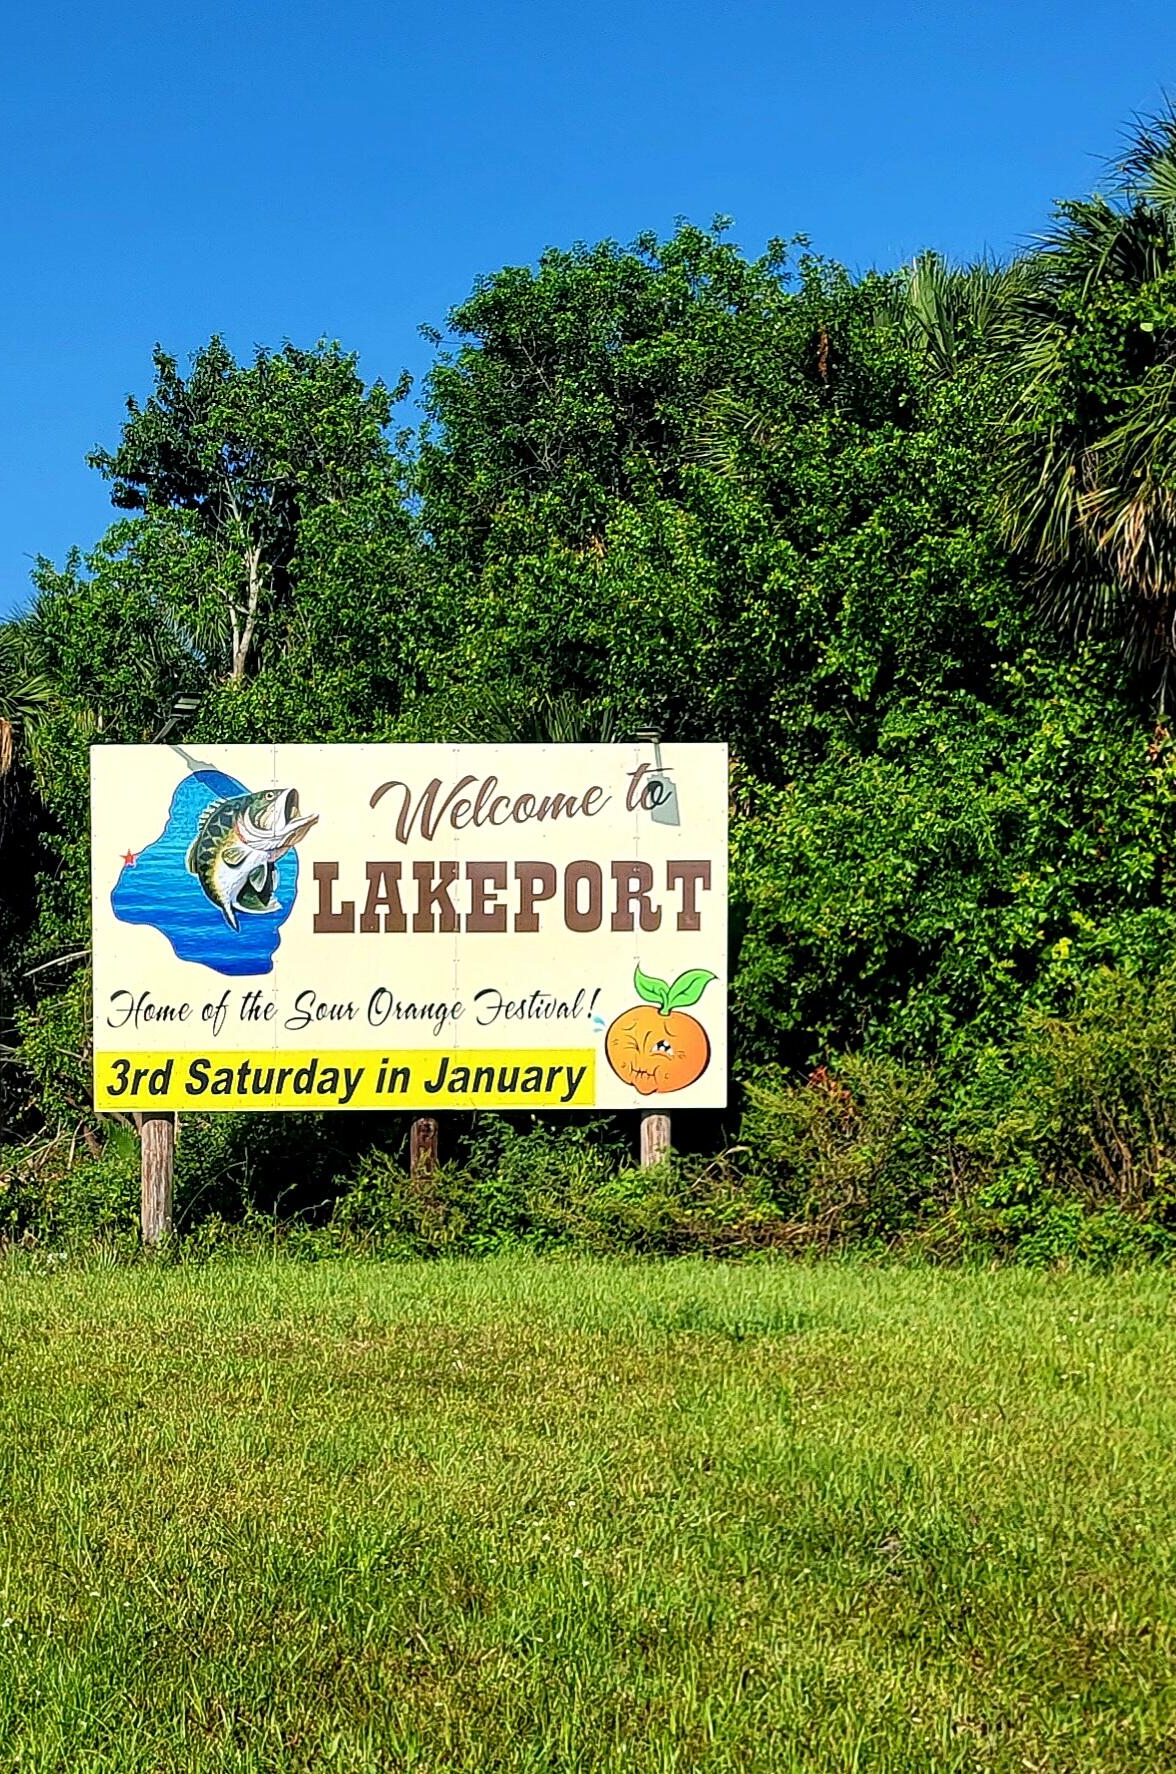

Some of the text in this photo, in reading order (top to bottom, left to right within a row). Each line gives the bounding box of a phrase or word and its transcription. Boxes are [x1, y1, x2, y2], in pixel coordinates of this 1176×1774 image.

[369, 763, 674, 845] Welcome to
[313, 860, 712, 933] LAKEPORT
[107, 987, 602, 1037] Home of the Sour Orange Festival!
[106, 1057, 587, 1104] 3rd Saturday in January
